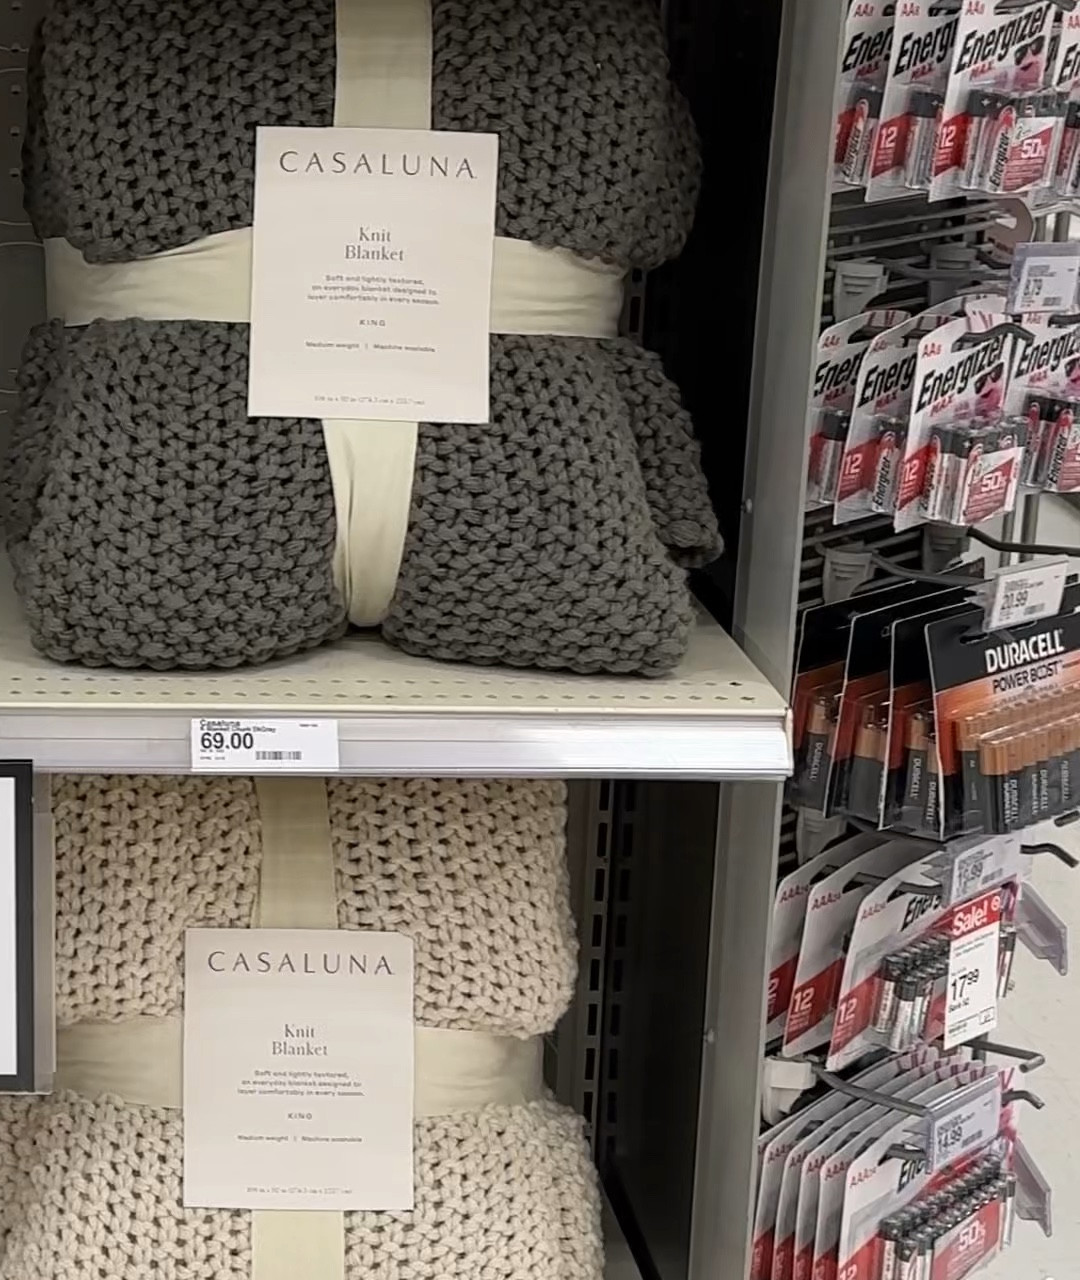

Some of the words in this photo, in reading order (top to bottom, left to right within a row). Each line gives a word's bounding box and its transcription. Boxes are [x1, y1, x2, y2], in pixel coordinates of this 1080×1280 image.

[893, 17, 960, 78] Energi
[955, 3, 1052, 75] Energizer
[880, 126, 897, 148] 12
[940, 125, 956, 148] 12
[280, 150, 475, 179] CASALUNA
[360, 227, 391, 242] Knit
[345, 245, 404, 261] Blanket
[915, 332, 1008, 415] Energizer
[843, 453, 862, 475] 12
[902, 458, 920, 480] 12
[984, 628, 1065, 673] DURACELL
[993, 670, 1029, 694] POWER
[201, 732, 254, 750] 69.00
[952, 900, 988, 937] Sale!
[208, 951, 394, 975] CASALUNA
[793, 988, 814, 1011] 12
[839, 997, 856, 1023] 12
[285, 1024, 314, 1038] Knit
[272, 1041, 327, 1055] Blanket
